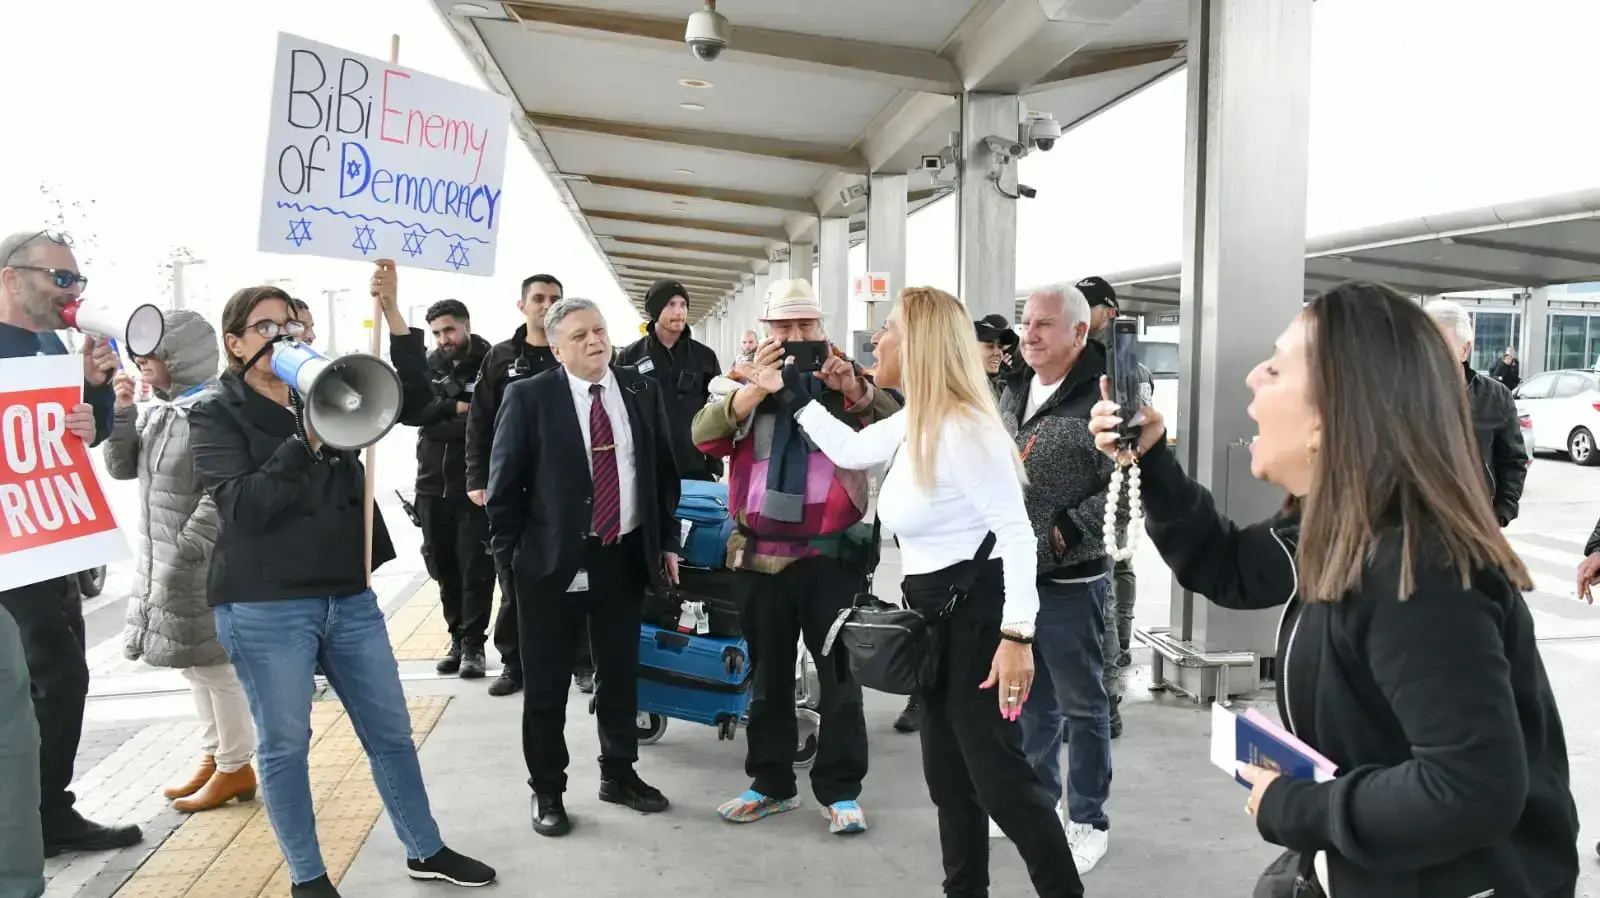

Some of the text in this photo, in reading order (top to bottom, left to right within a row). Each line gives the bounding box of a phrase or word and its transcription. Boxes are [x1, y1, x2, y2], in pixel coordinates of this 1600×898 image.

[288, 49, 488, 186] BiBi Enemy
[0, 472, 97, 538] RUN
